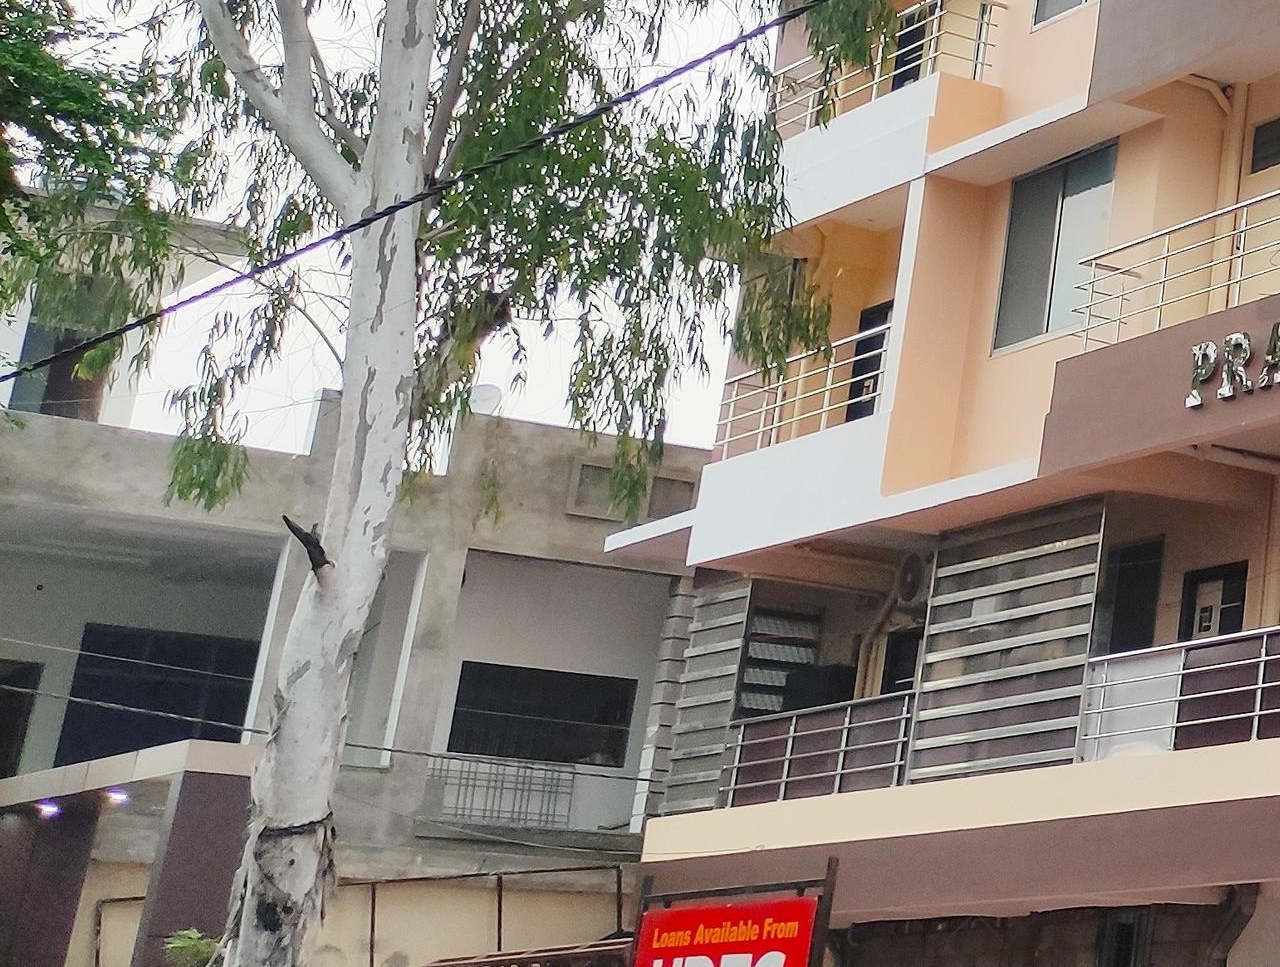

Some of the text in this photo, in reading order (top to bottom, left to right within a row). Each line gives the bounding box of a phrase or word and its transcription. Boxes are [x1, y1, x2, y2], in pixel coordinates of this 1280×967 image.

[652, 918, 799, 948] Loans Available From
